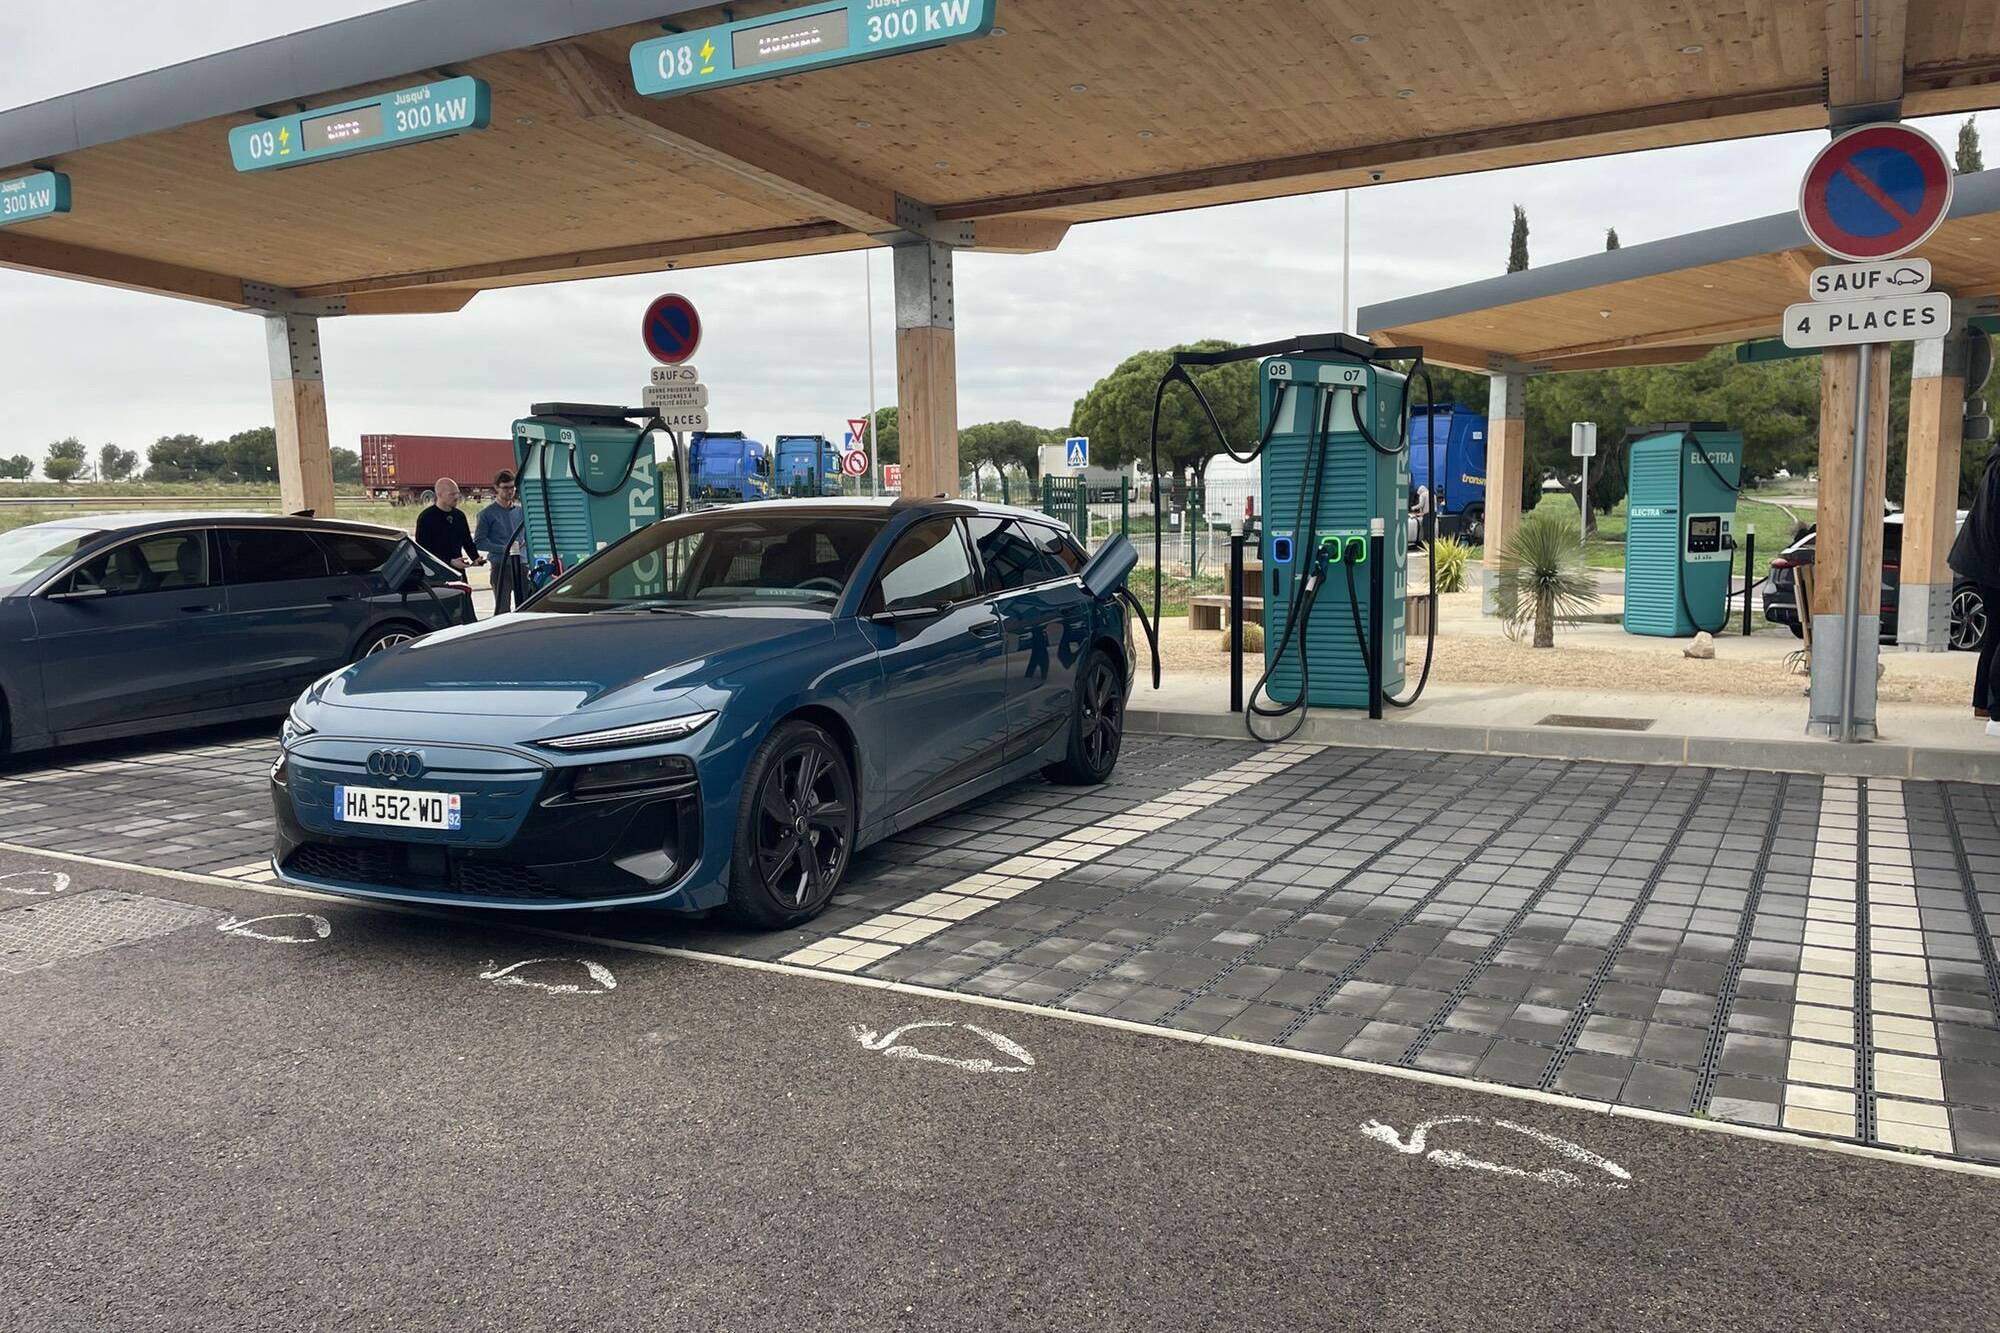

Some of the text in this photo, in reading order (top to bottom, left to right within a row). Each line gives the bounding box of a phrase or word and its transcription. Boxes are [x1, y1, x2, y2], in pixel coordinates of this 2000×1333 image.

[867, 0, 970, 42] 300 kW
[658, 46, 693, 80] 08
[393, 86, 431, 106] Jusqu'à
[396, 97, 467, 132] 300 kW
[249, 131, 274, 159] 09
[3, 188, 50, 214] 300 kW
[1816, 270, 1881, 293] SAUF
[1797, 307, 1935, 333] 4 PLACES
[652, 370, 678, 381] SAUF
[1269, 364, 1287, 376] 08
[1343, 370, 1361, 381] 07
[517, 426, 526, 434] 10
[560, 431, 572, 440] 09
[1630, 508, 1660, 517] ELECTRA
[448, 812, 460, 826] 92
